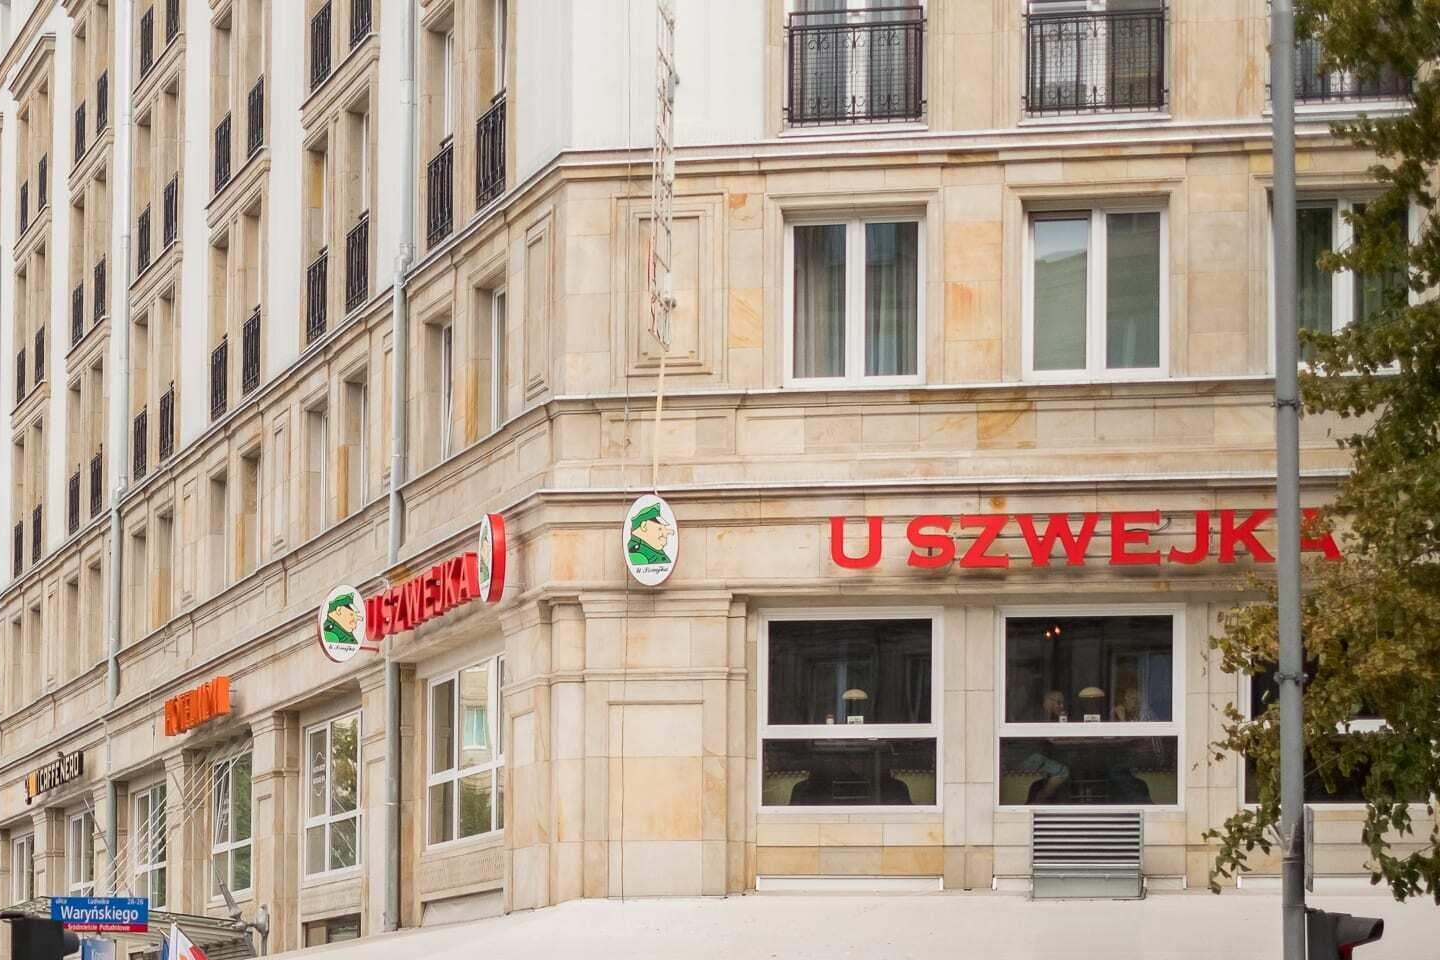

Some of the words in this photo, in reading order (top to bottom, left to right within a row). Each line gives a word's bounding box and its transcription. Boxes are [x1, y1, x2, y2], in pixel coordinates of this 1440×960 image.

[829, 515, 883, 569] U
[906, 507, 1343, 569] SZWEJKA
[382, 552, 481, 636] SZWEJKA
[60, 751, 80, 782] NERO
[60, 905, 139, 924] Waryńskiego
